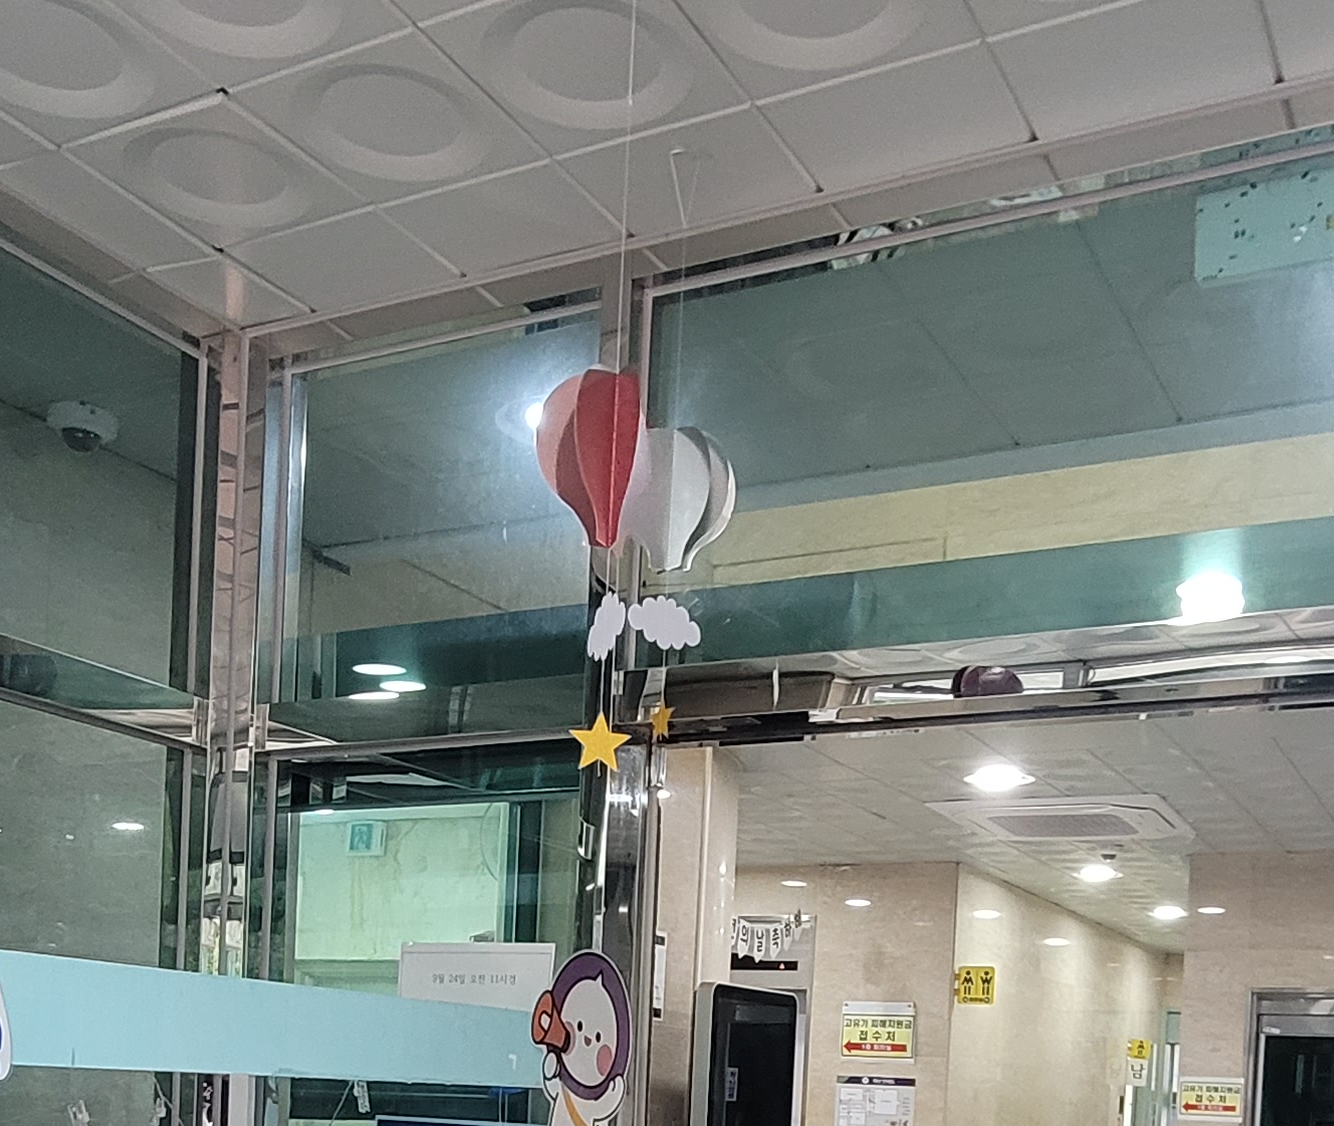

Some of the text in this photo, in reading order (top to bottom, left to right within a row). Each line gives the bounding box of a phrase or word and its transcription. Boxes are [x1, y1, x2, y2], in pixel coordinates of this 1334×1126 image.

[844, 1018, 912, 1029] 고유가 피해지원금
[1131, 1063, 1146, 1079] 남
